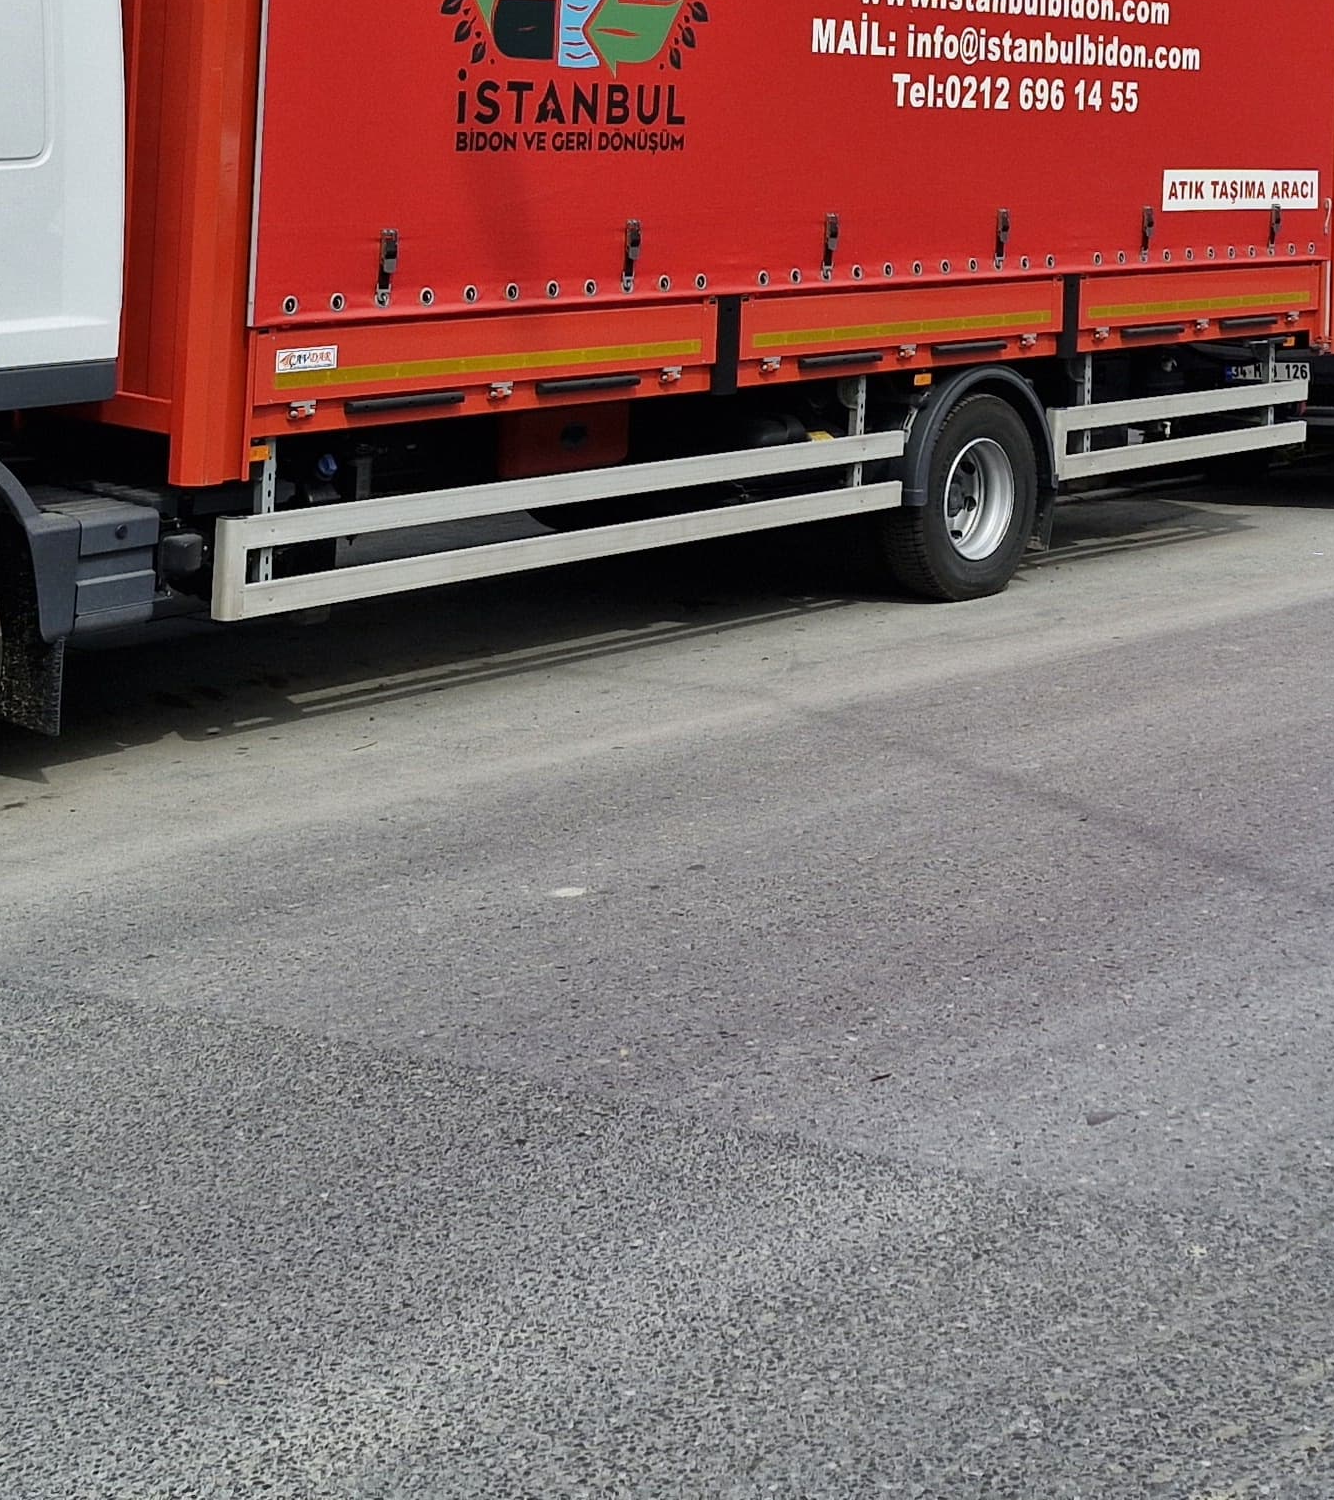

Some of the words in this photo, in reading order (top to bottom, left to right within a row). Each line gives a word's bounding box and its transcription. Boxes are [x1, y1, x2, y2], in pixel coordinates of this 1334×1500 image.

[811, 12, 897, 57] MAİL:
[907, 23, 1201, 70] info@istanbulbidon.com
[456, 68, 686, 125] İSTANBUL
[892, 73, 1011, 110] Tel:0212
[1019, 77, 1065, 111] 696
[1074, 79, 1102, 112] 14
[1110, 81, 1139, 113] 55
[456, 128, 517, 151] BİDON
[523, 131, 547, 151] VE
[552, 128, 593, 151] GERİ
[598, 128, 685, 155] DÖNÜŞÜM
[1168, 180, 1205, 200] ATIK
[1210, 180, 1266, 204] TAŞIMA
[1271, 180, 1314, 199] ARACI
[1285, 364, 1308, 380] 126
